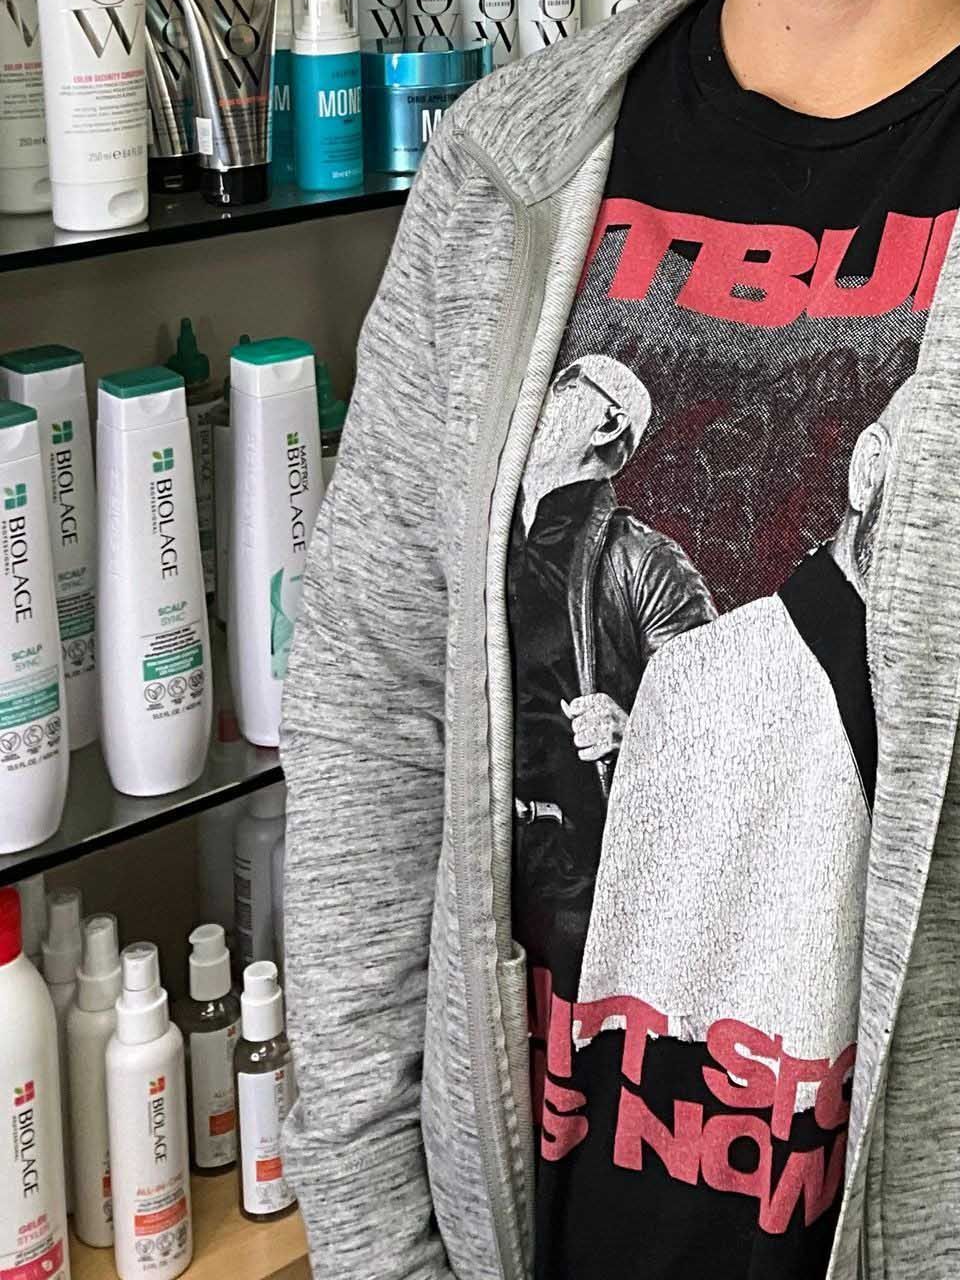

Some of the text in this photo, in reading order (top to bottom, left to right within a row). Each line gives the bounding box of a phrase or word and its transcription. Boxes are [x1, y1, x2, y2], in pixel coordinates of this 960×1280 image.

[577, 198, 957, 329] TBU
[55, 449, 79, 548] BIOLAGE
[285, 446, 308, 555] BIOLAGE
[298, 445, 310, 492] MATRIX
[7, 516, 33, 624] BIOLAGE
[154, 479, 180, 582] BIOLAGE
[11, 644, 43, 662] SCALP
[157, 600, 188, 617] SCALP
[17, 1107, 40, 1196] BIOLAGE
[152, 1096, 169, 1165] BIOLAGE
[613, 1086, 848, 1235] NOW
